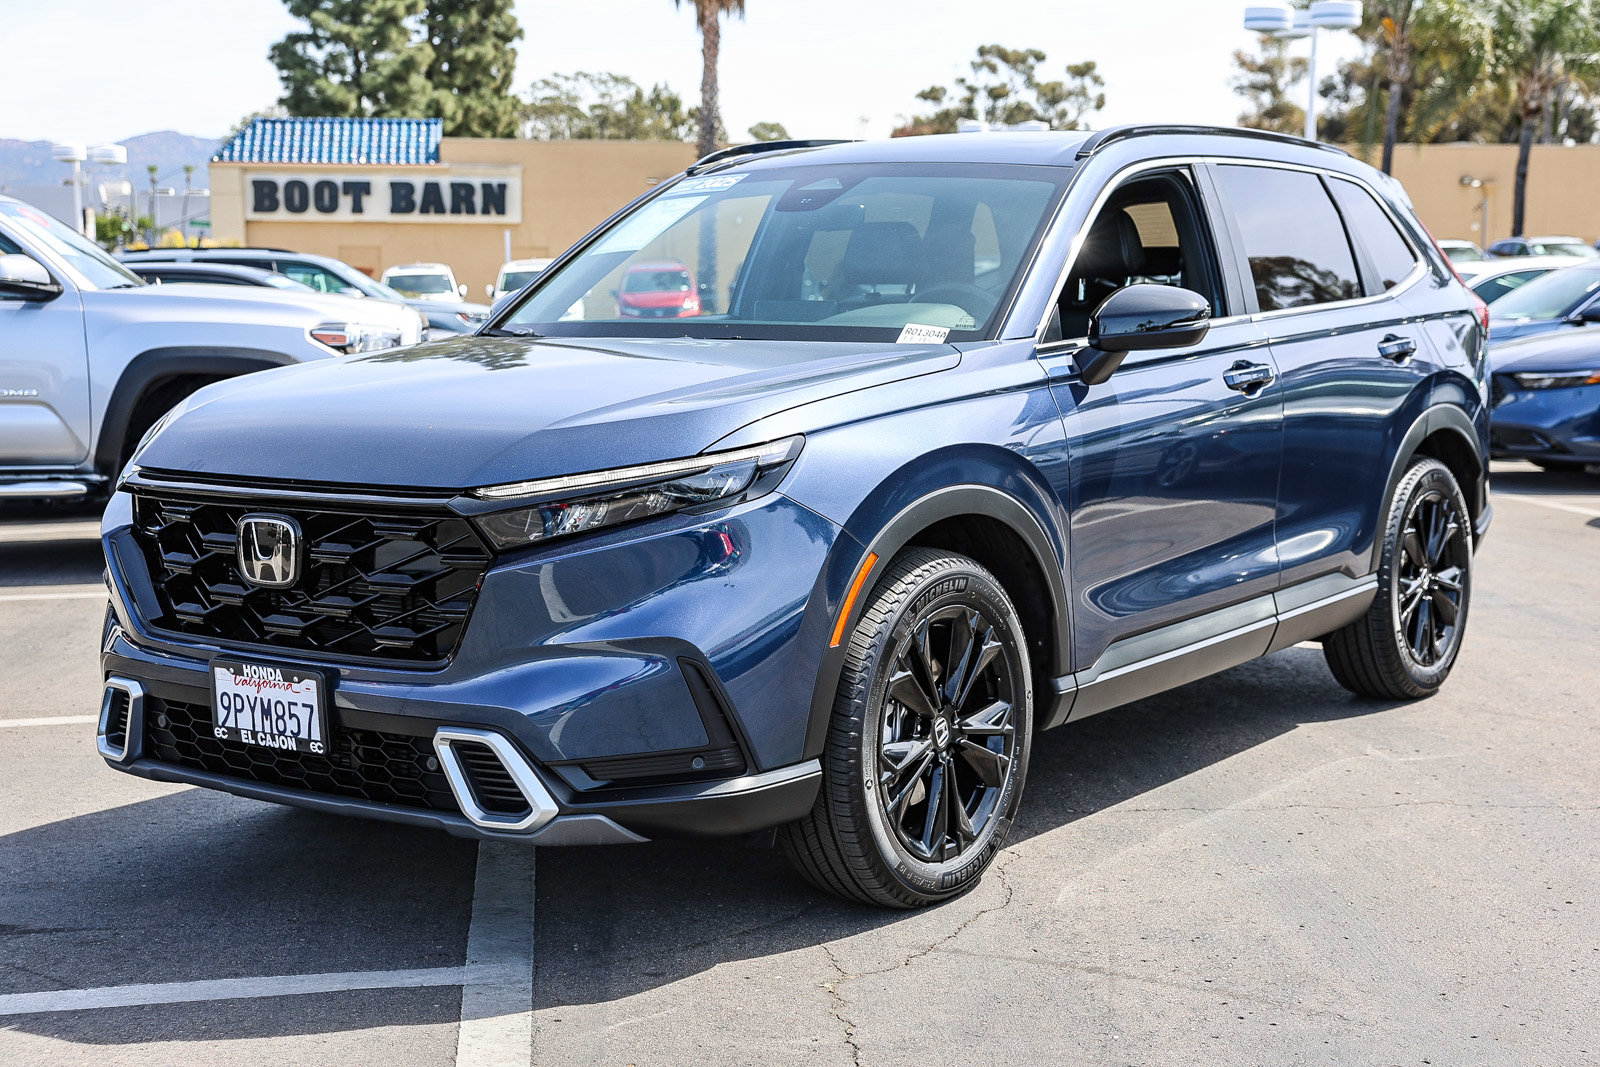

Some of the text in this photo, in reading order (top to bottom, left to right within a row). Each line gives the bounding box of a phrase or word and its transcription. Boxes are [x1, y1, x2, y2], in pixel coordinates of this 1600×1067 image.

[252, 179, 507, 216] BOOT BARN
[904, 327, 947, 339] R01304A
[916, 578, 968, 614] MICHELIN
[242, 664, 284, 682] HONDA
[220, 691, 315, 741] 9PYM857
[240, 729, 298, 751] EL CAJON
[943, 845, 992, 888] MICHELIN
